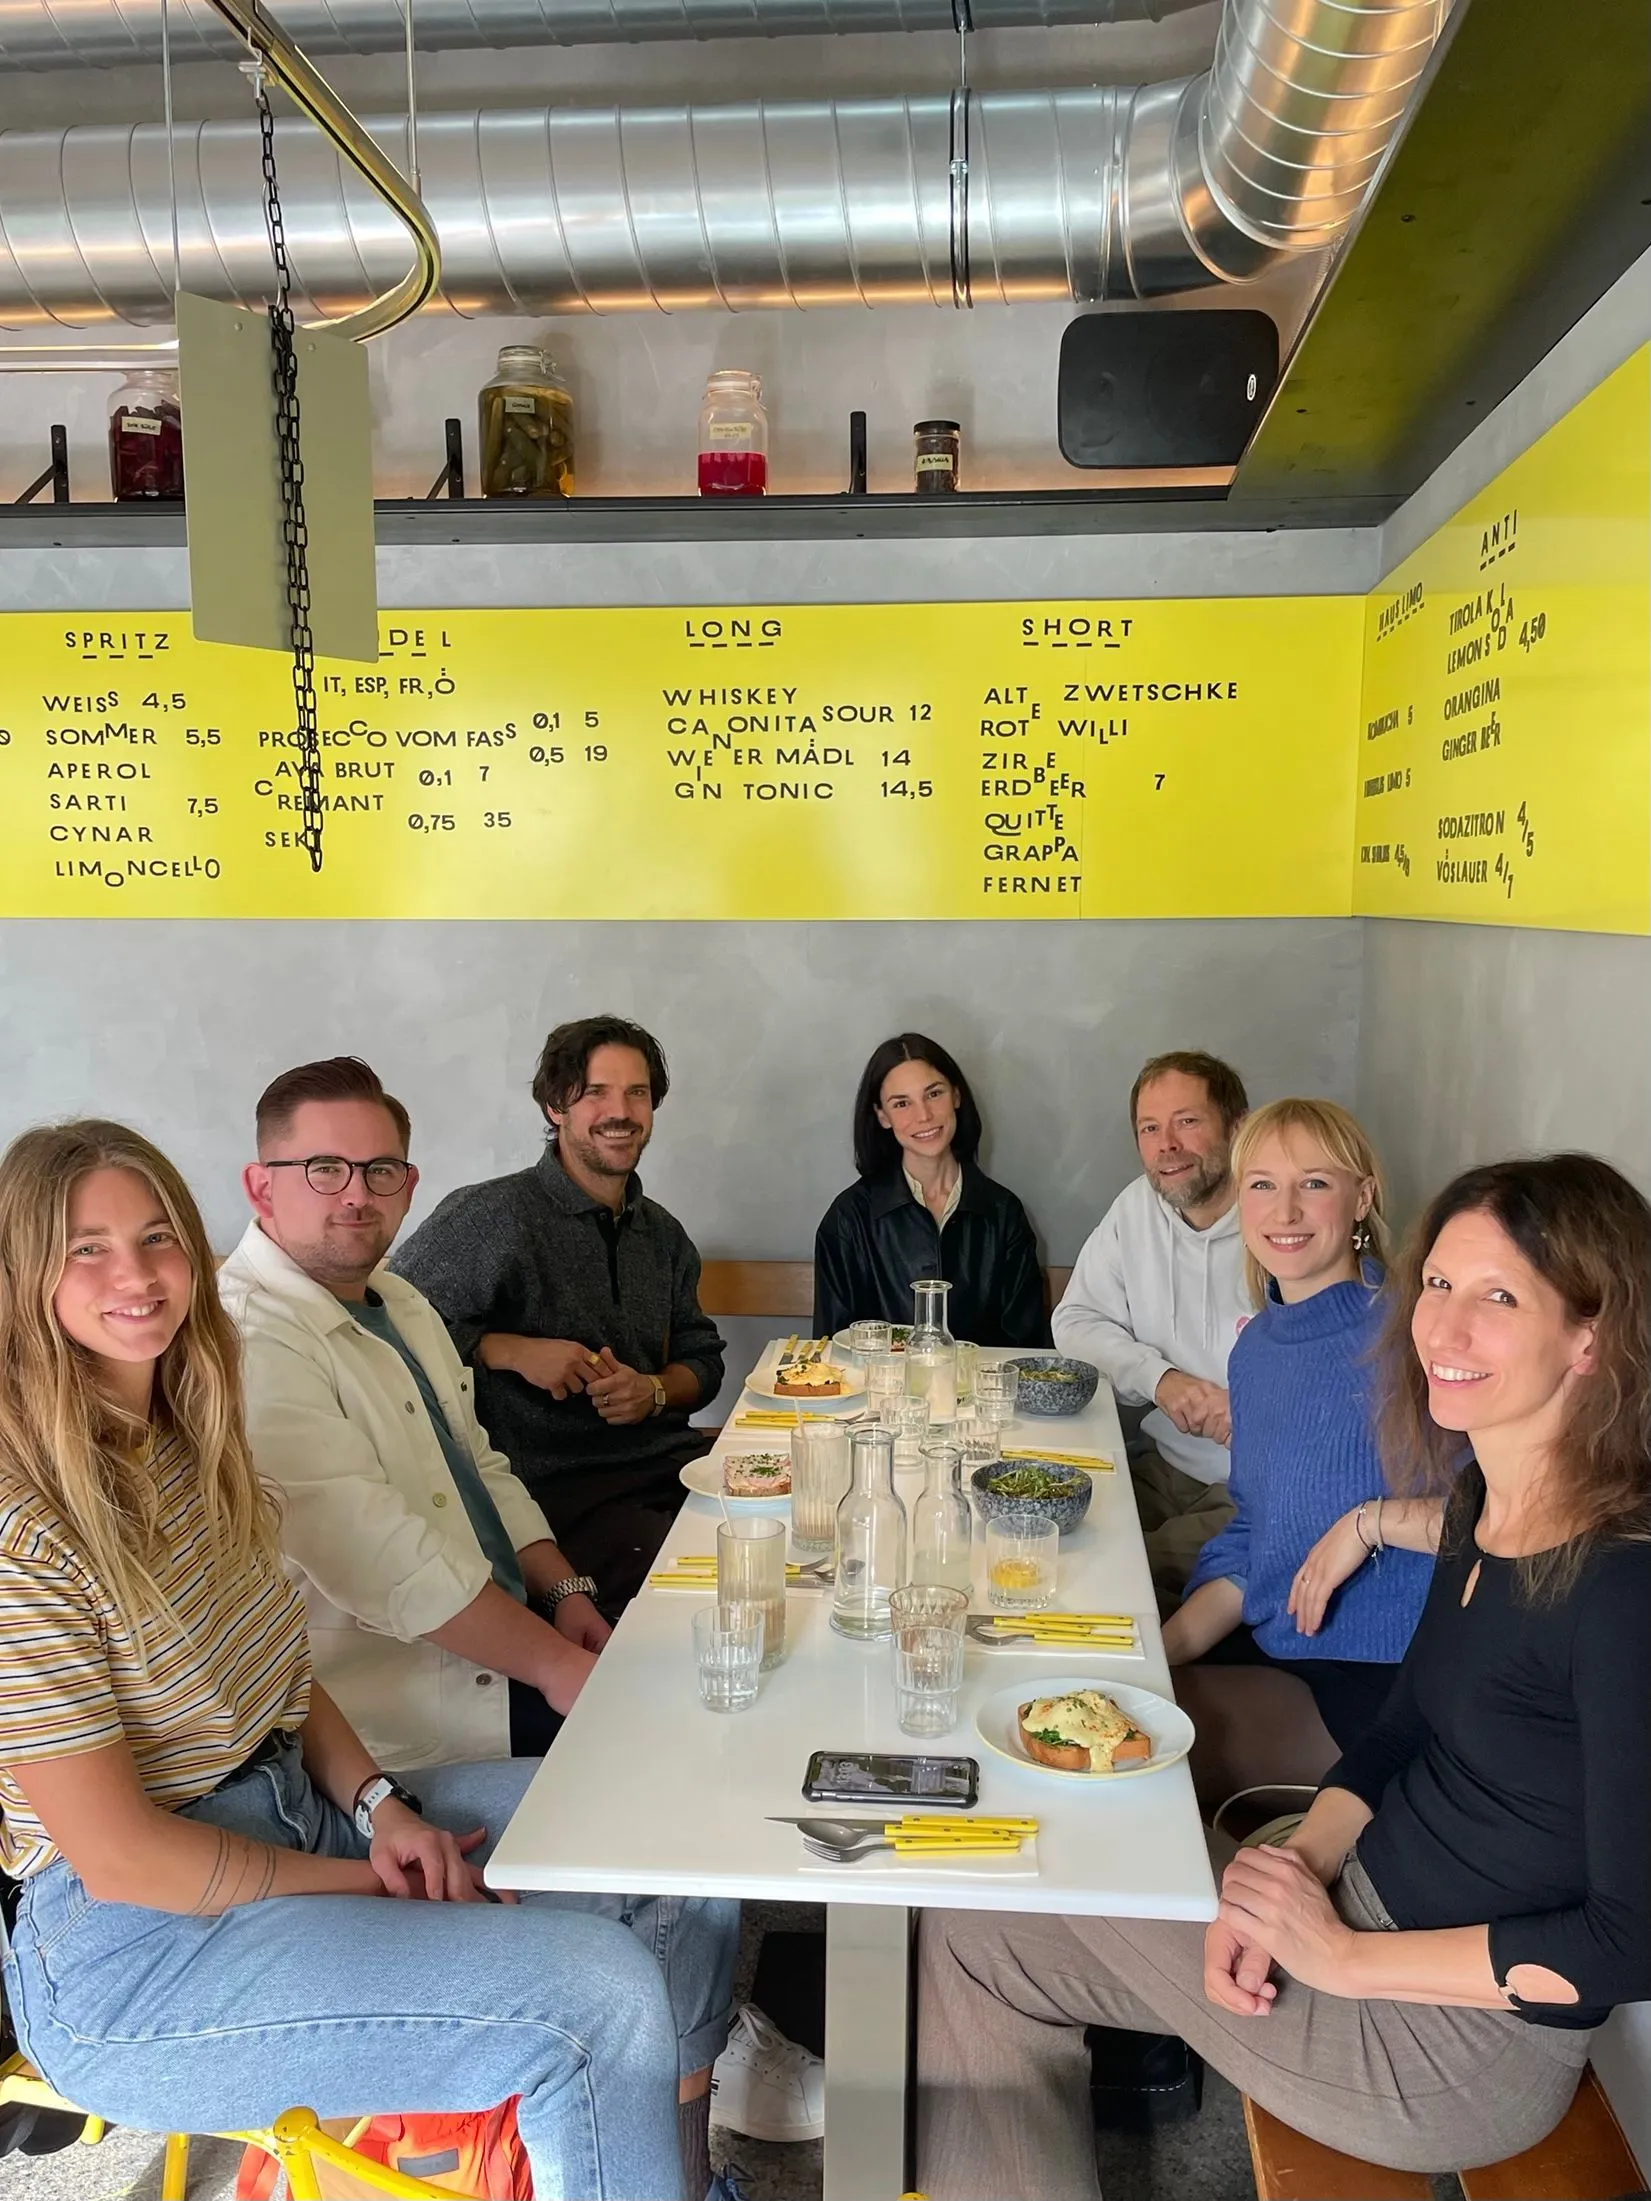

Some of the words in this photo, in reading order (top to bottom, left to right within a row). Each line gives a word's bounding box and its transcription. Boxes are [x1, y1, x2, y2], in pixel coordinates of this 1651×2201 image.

[1481, 508, 1518, 557] ANTI
[1449, 594, 1483, 636] TIROLA
[686, 620, 782, 638] LONG
[1022, 618, 1133, 638] SHORT
[65, 631, 170, 650] SPRITZ
[1446, 636, 1483, 676] LEMON
[1518, 612, 1546, 653] 4,50
[323, 676, 346, 697] IT,
[355, 676, 389, 699] ESP,
[1063, 682, 1238, 702] ZWETSCHKE
[42, 690, 119, 713] WEISS
[141, 692, 186, 713] 4,5
[662, 687, 797, 707] WHISKEY
[822, 705, 895, 723] SOUR
[909, 703, 932, 722] 12
[1444, 677, 1501, 723] ORANGINA
[1407, 705, 1413, 725] 5
[46, 722, 158, 746] SOMMER
[186, 728, 221, 748] 5,5
[395, 730, 457, 748] VOM
[466, 722, 517, 748] FASS
[532, 712, 560, 733] 0,1
[584, 711, 599, 728] 5
[666, 714, 819, 751] CANONITA
[1057, 719, 1127, 745] WILLI
[1442, 730, 1477, 761] GINGER
[1480, 711, 1501, 750] BEER
[529, 746, 565, 767] 0,5
[584, 745, 608, 762] 19
[881, 749, 911, 767] 14
[47, 762, 151, 780] APEROL
[335, 761, 395, 779] BRUT
[418, 769, 452, 787] 0,1
[479, 765, 490, 782] 7
[1154, 773, 1166, 791] 7
[1405, 767, 1412, 788] 5
[743, 782, 834, 801] TONIC
[881, 780, 933, 800] 14,5
[49, 793, 126, 812] SARTI
[187, 797, 219, 818] 7,5
[408, 813, 456, 834] 0,75
[483, 811, 512, 828] 35
[984, 804, 1065, 837] QUITTE
[1438, 810, 1505, 840] SODAZITRON
[49, 825, 153, 843] CYNAR
[264, 830, 322, 850] SEK
[983, 836, 1079, 862] GRAPPA
[55, 855, 221, 888] LIMONCELLO
[983, 876, 1082, 894] FERNET
